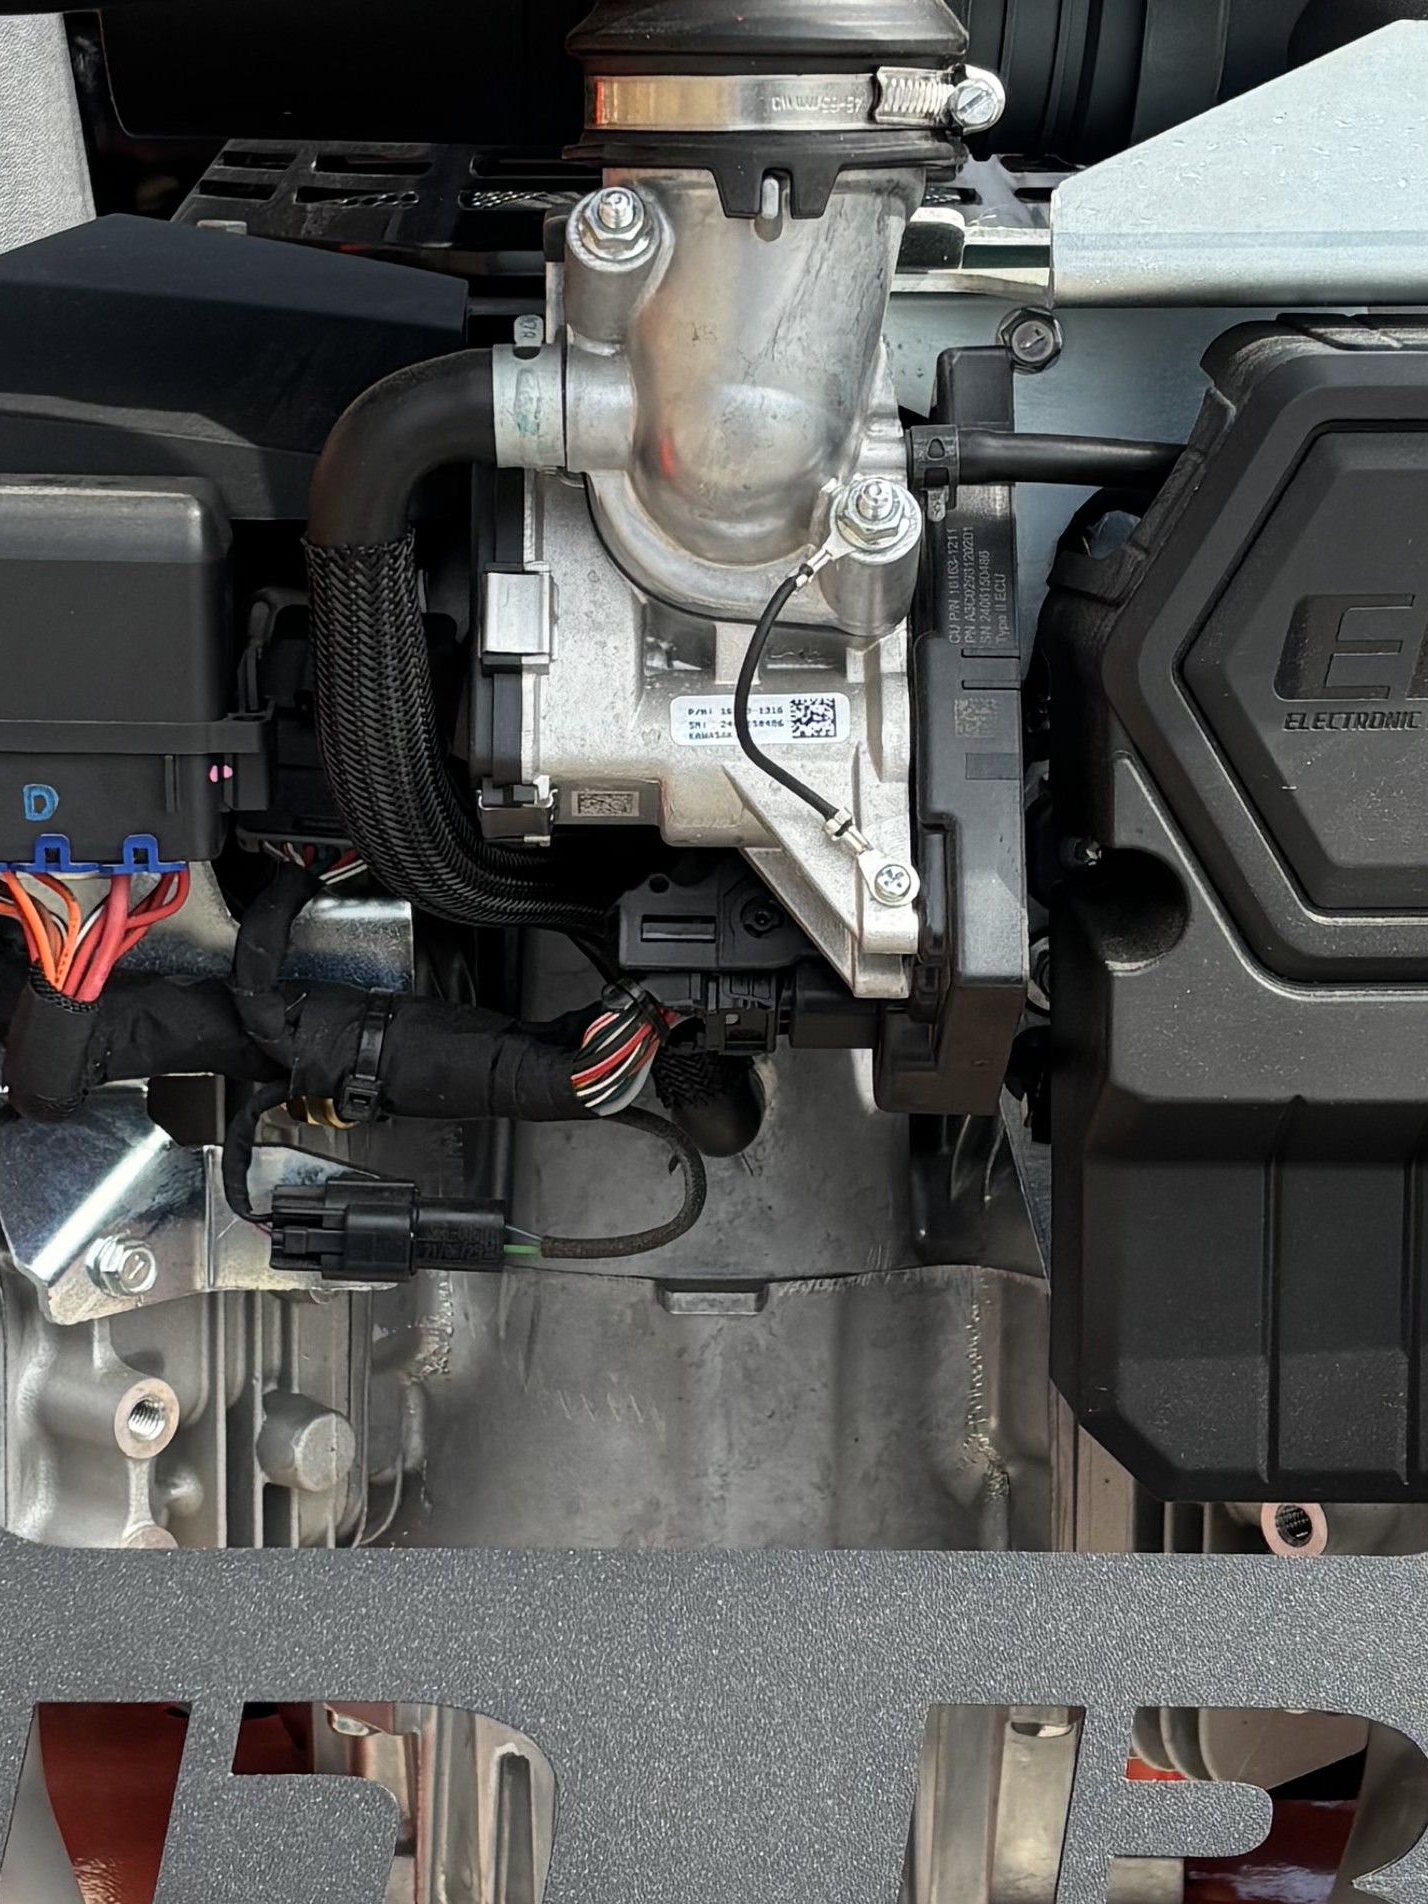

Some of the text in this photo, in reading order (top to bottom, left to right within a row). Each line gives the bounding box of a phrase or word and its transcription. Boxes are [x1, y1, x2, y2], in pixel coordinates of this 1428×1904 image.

[993, 572, 1007, 602] ECU
[994, 614, 1010, 644] Type
[1281, 709, 1423, 732] ELECTRONIC
[23, 783, 60, 822] D
